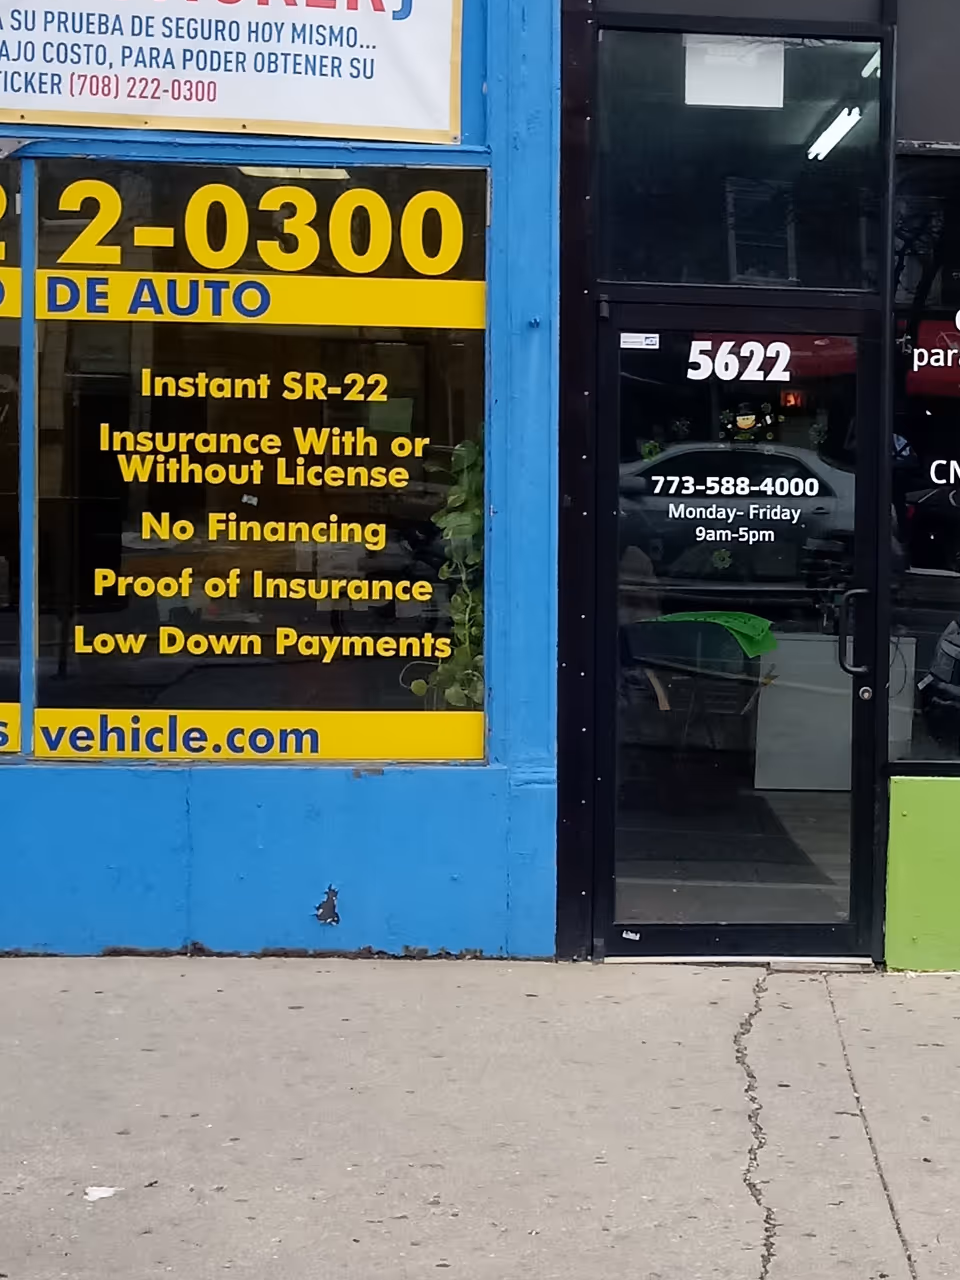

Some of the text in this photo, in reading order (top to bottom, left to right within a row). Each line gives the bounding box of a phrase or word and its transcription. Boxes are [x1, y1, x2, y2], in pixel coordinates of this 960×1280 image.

[11, 10, 35, 31] SU
[44, 10, 123, 36] PRUEBA
[131, 16, 154, 38] DE
[162, 17, 240, 41] SEGURO
[248, 22, 284, 43] HOY
[291, 23, 375, 49] MISMO...
[43, 42, 112, 69] COSTO,
[121, 46, 175, 69] PARA
[183, 49, 246, 72] PODER
[254, 52, 341, 78] OBTENER
[350, 58, 374, 79] SU
[70, 72, 119, 99] (708)
[127, 77, 216, 101] 222-0300
[47, 277, 109, 314] DE
[129, 279, 271, 318] AUTO
[687, 341, 790, 381] 5622
[142, 369, 387, 401] Instant SR-22
[100, 424, 429, 457] Insurance With or
[118, 454, 409, 487] Without License
[652, 476, 818, 495] 773-588-4000
[669, 504, 800, 523] Monday- Friday
[142, 512, 385, 550] No Financing
[696, 527, 774, 544] 9am-5pm
[95, 568, 432, 600] Proof of Insurance
[75, 626, 450, 662] Low Down Payments
[40, 714, 320, 755] vehicle.com
